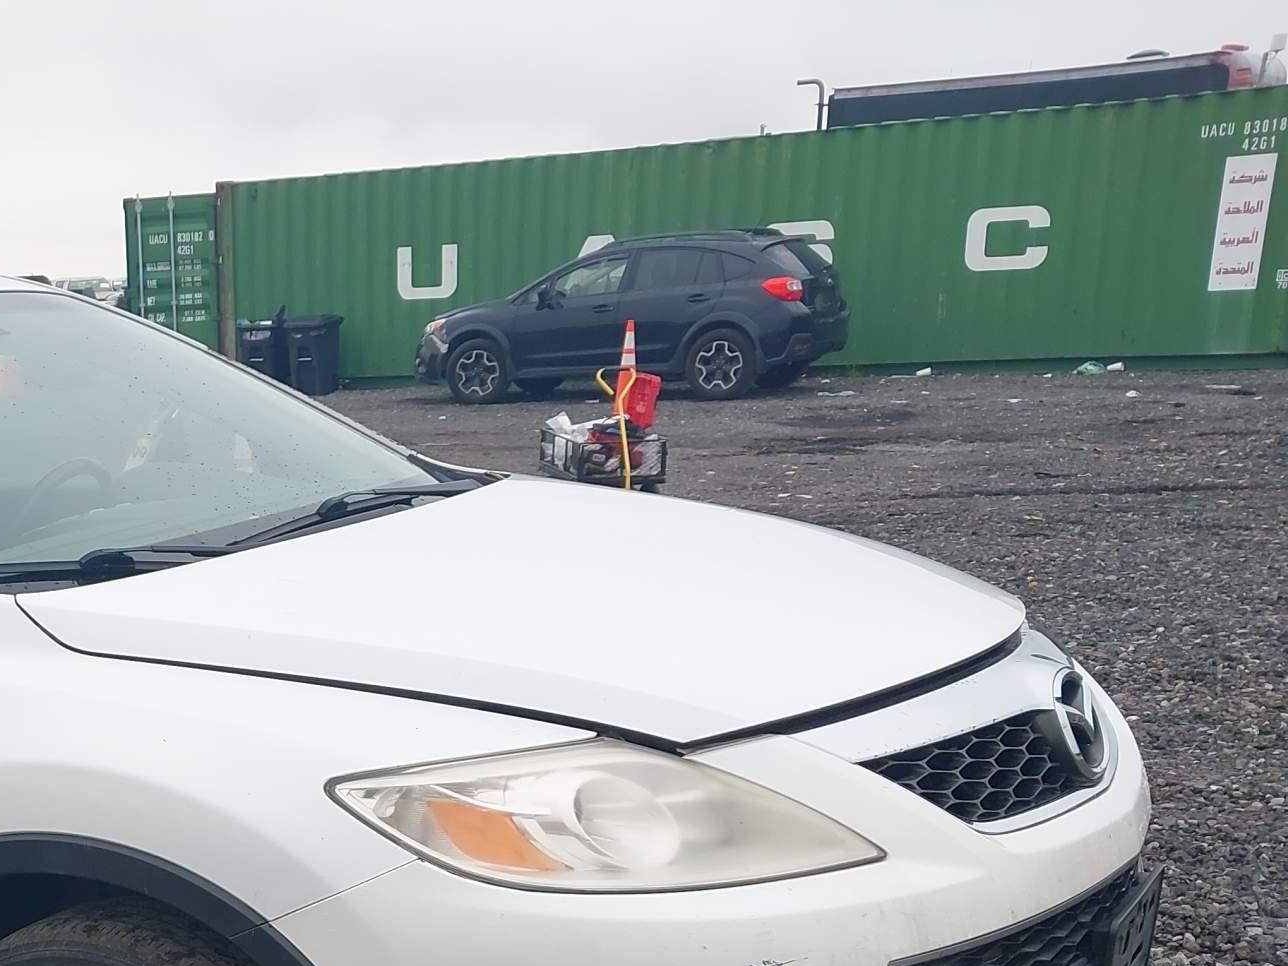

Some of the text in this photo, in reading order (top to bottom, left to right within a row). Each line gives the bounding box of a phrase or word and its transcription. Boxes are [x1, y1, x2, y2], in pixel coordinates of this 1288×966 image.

[1200, 122, 1235, 138] UACU
[1241, 135, 1276, 151] 42G1
[1228, 170, 1268, 184] شركة
